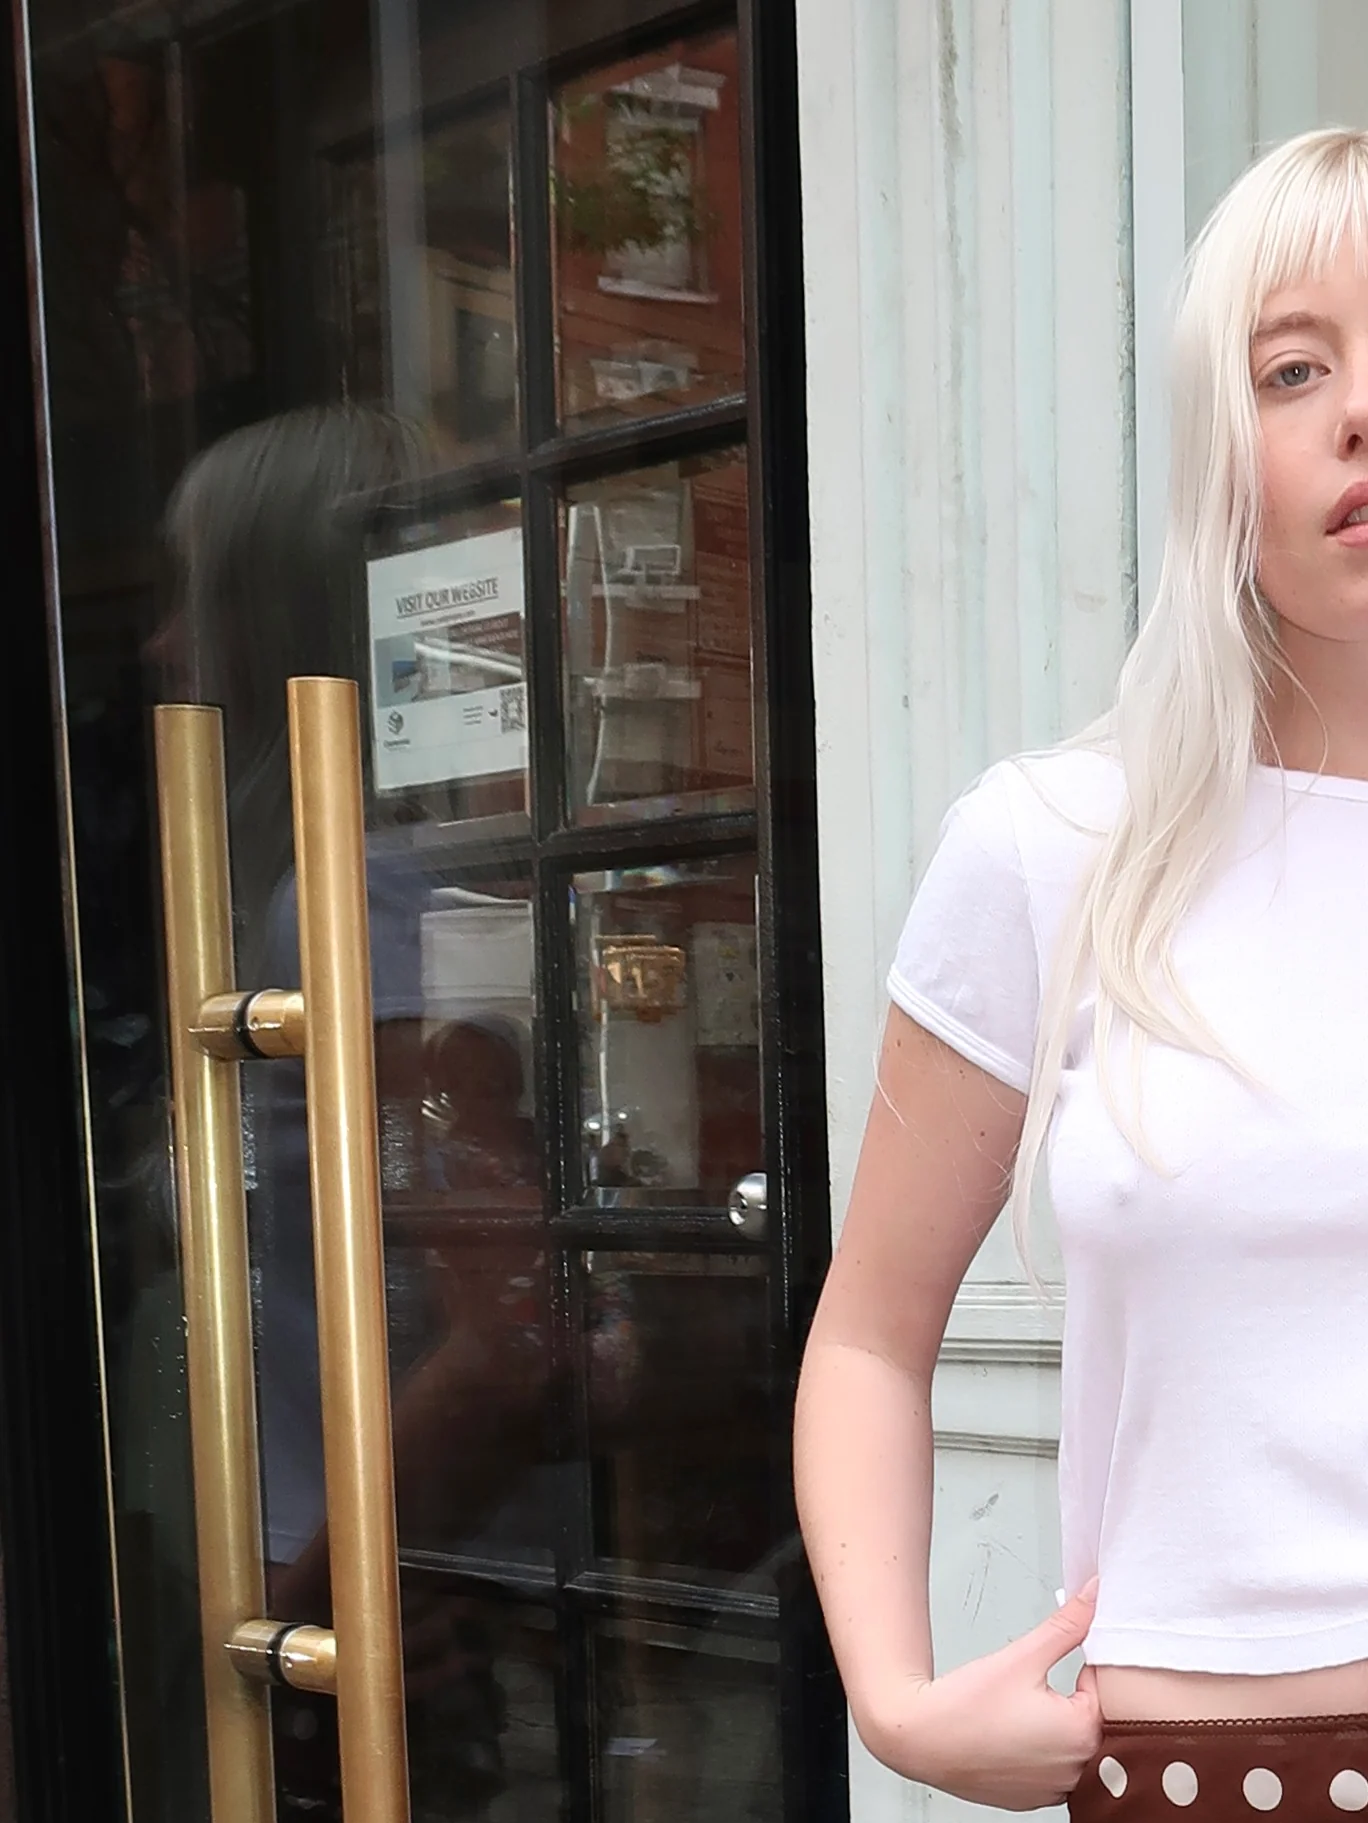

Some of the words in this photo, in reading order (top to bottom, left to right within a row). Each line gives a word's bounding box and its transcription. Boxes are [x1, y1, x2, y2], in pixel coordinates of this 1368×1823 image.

[395, 592, 423, 614] VISIT
[425, 588, 450, 609] OUR
[451, 577, 499, 605] WEBSITE
